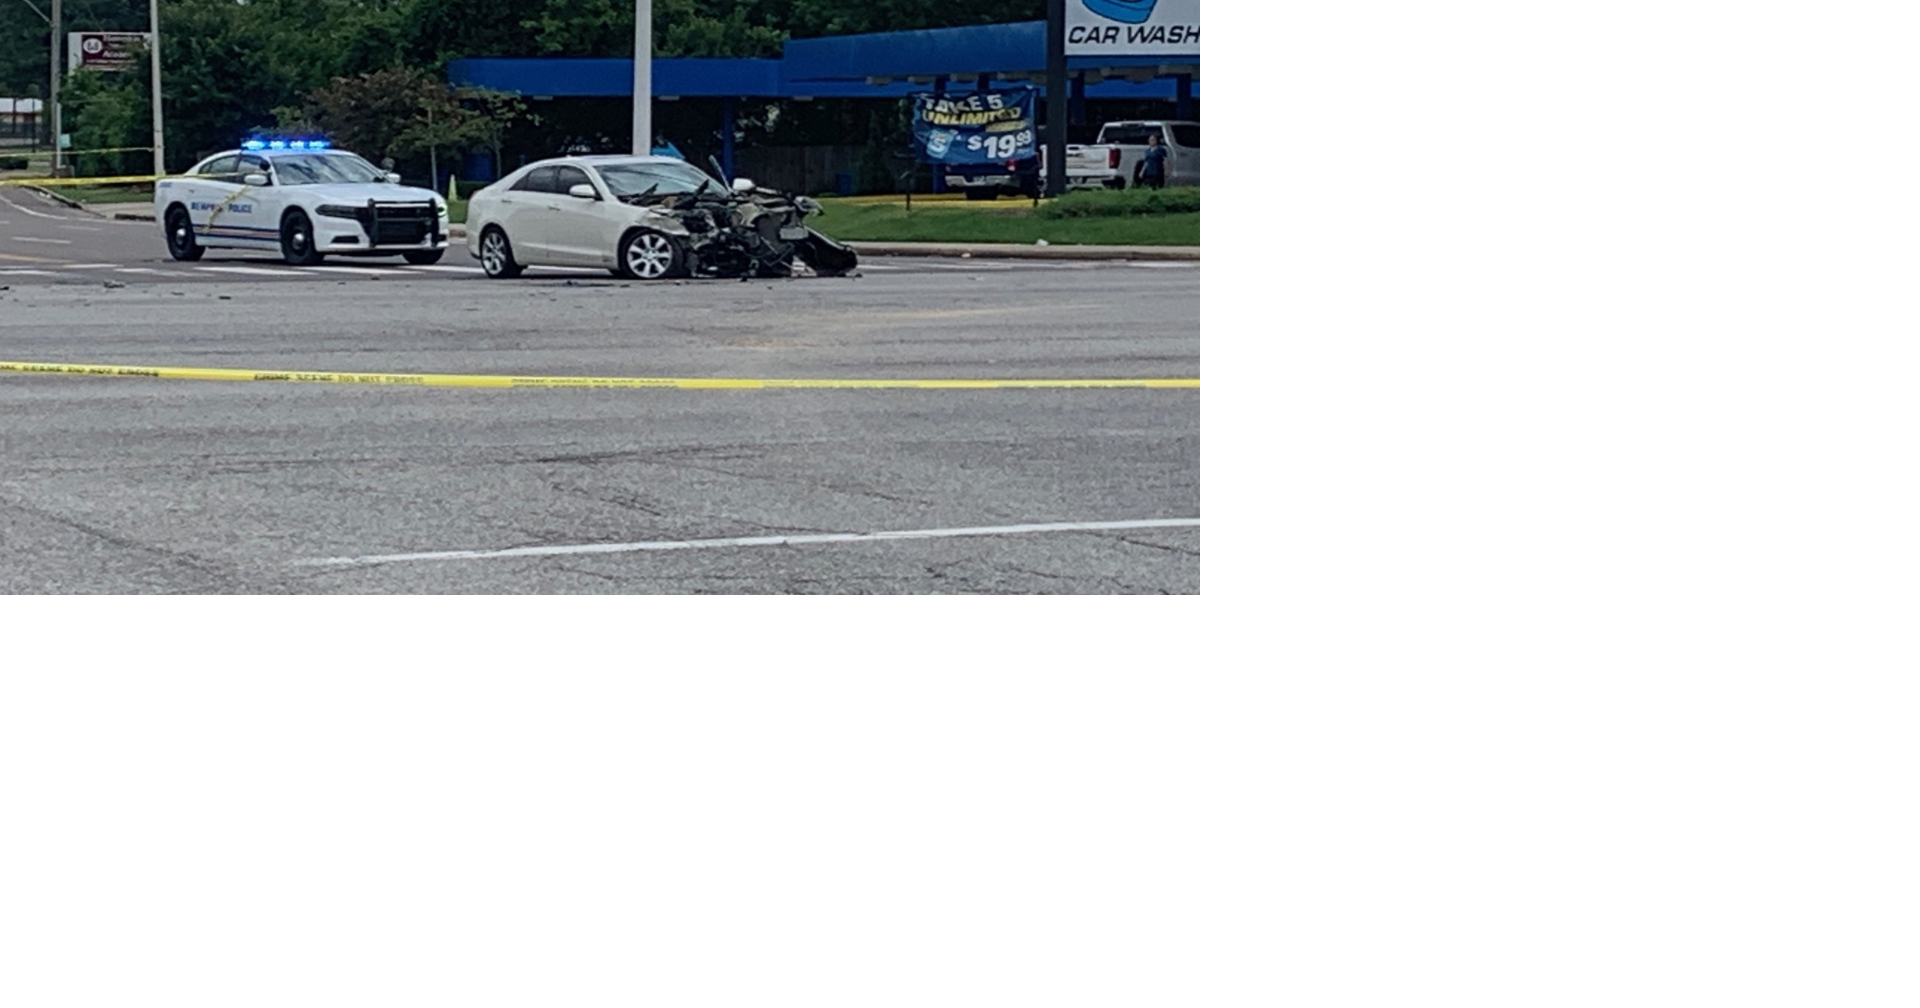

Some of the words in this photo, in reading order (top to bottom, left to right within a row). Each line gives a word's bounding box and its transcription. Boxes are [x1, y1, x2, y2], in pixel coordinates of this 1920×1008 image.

[1068, 26, 1120, 44] CAR
[1126, 25, 1200, 44] WASH
[920, 93, 983, 114] TAKE
[986, 94, 1003, 110] 5
